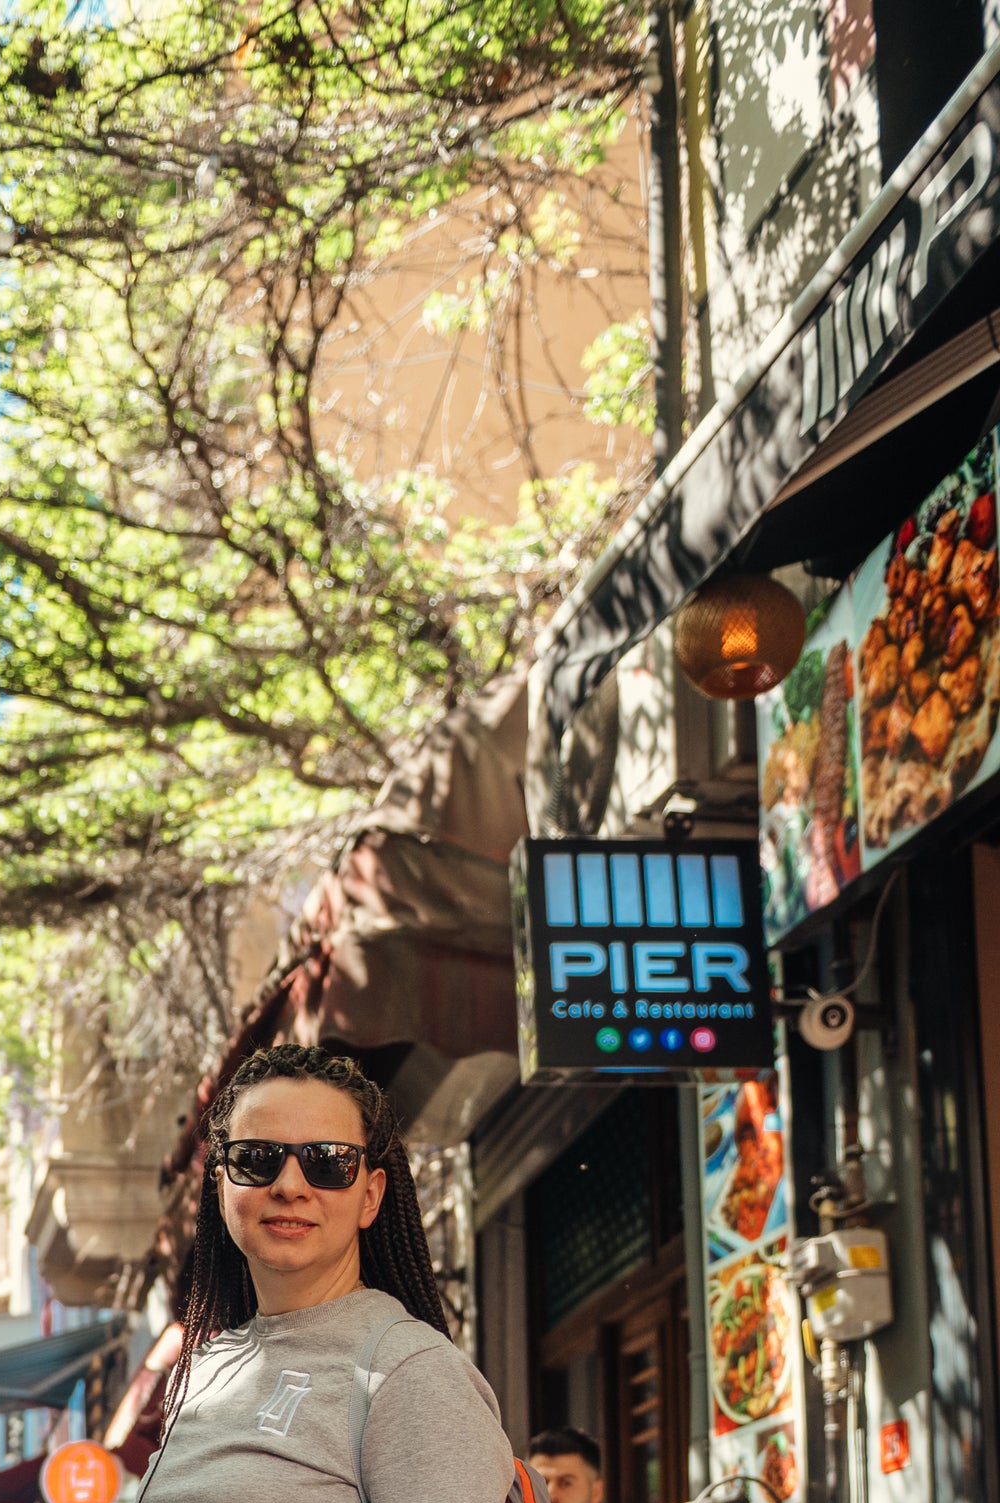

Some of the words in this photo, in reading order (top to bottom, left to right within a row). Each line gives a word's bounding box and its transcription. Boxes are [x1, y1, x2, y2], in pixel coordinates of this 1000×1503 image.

[549, 941, 752, 994] PIER
[551, 1000, 605, 1019] Cafe
[612, 1001, 629, 1018] &
[634, 1000, 755, 1019] Restaurant
